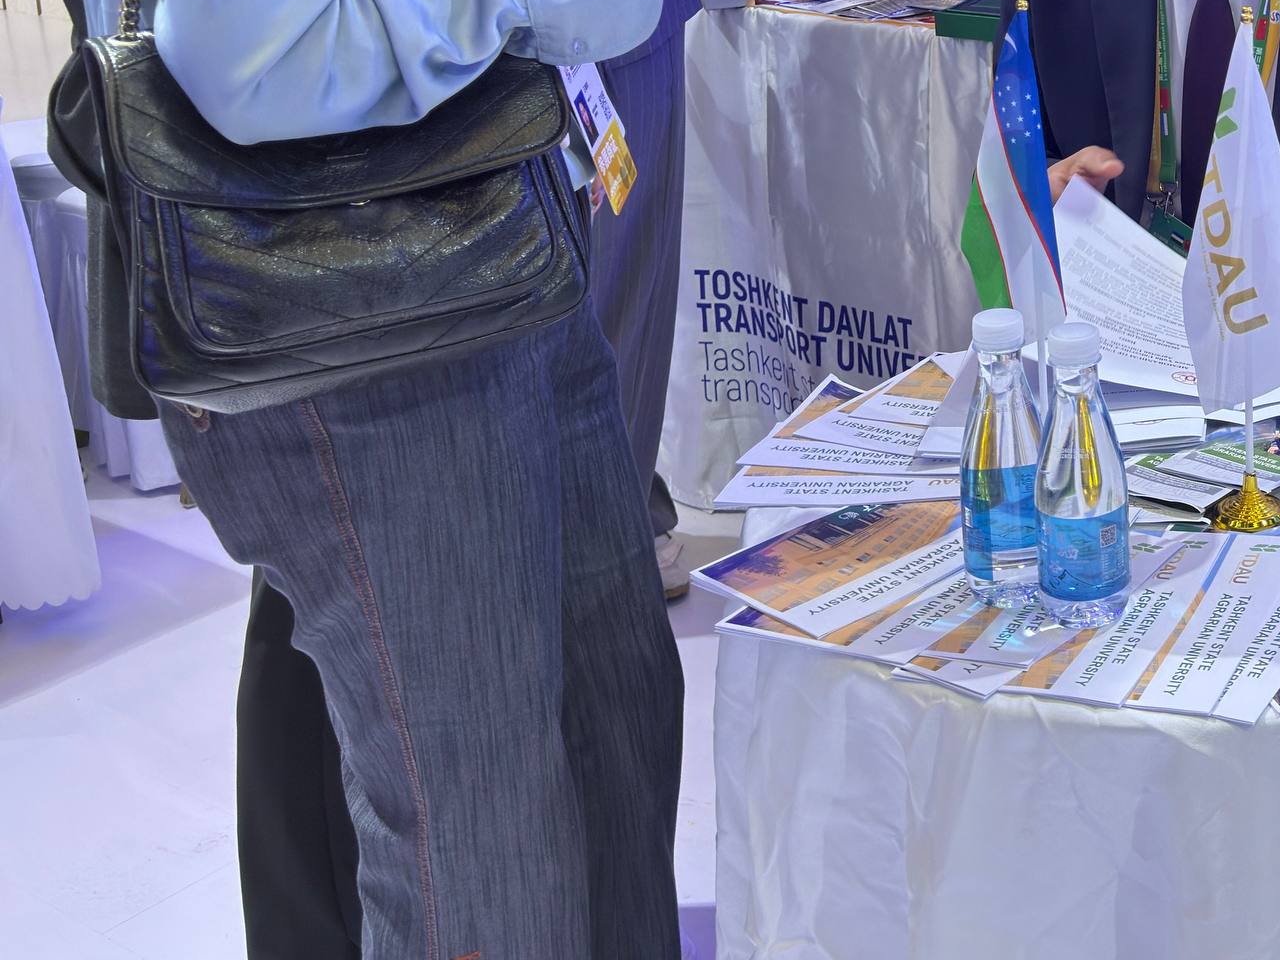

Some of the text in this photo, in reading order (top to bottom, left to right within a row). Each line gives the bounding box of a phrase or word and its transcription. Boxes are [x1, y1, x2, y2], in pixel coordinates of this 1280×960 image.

[1200, 154, 1269, 336] TDAU
[694, 269, 912, 350] TOSHKENT DAVLAT
[696, 303, 926, 378] TRANSPORT UNIVE
[698, 341, 799, 391] Tashkent
[701, 374, 803, 417] transpor
[881, 401, 939, 413] IVERSITY
[771, 445, 849, 456] UNIVERSITY
[832, 418, 902, 438] UNIVERSITY
[854, 432, 893, 443] STATE
[800, 453, 913, 467] TASHKENT STATE
[837, 479, 915, 488] AGRARIAN
[838, 486, 910, 495] TASHKENT
[808, 539, 960, 616] AGRARIAN UNIVERSITY
[858, 546, 964, 604] ASHKENT STATE
[1232, 553, 1260, 585] TDAU
[876, 598, 943, 645] UNIVERSITY
[918, 604, 956, 628] STATE
[1112, 591, 1173, 665] TASHKENT STATE
[1115, 588, 1155, 635] AGRARIAN
[1197, 595, 1252, 672] TASHKENT STATE
[1075, 635, 1121, 687] UNIVERSITY
[1163, 593, 1233, 696] AGRARIAN UNIVERSITY
[1247, 649, 1277, 679] STATE
